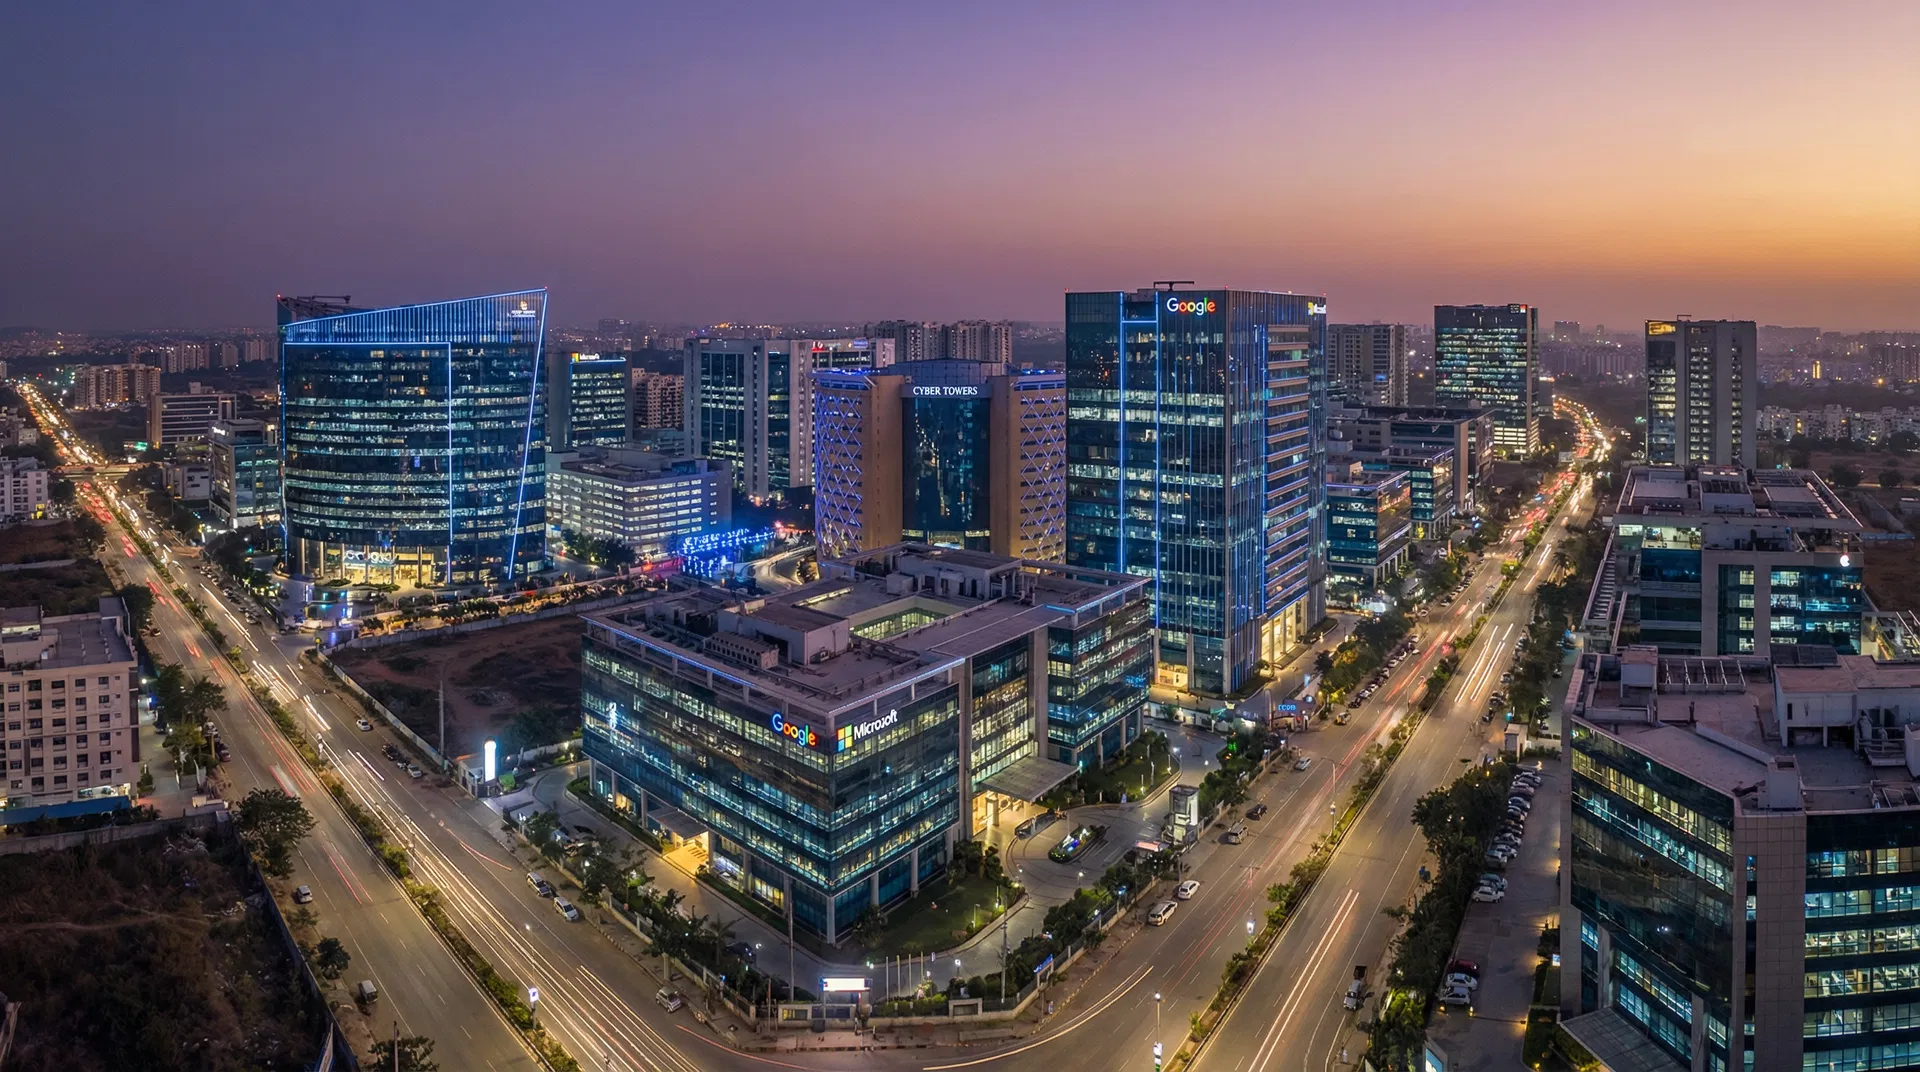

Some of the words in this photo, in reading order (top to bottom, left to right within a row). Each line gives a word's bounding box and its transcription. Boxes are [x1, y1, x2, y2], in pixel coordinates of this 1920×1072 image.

[1166, 296, 1216, 316] Google
[912, 386, 941, 396] CYBER
[942, 386, 978, 396] TOWERS
[771, 713, 816, 746] Google
